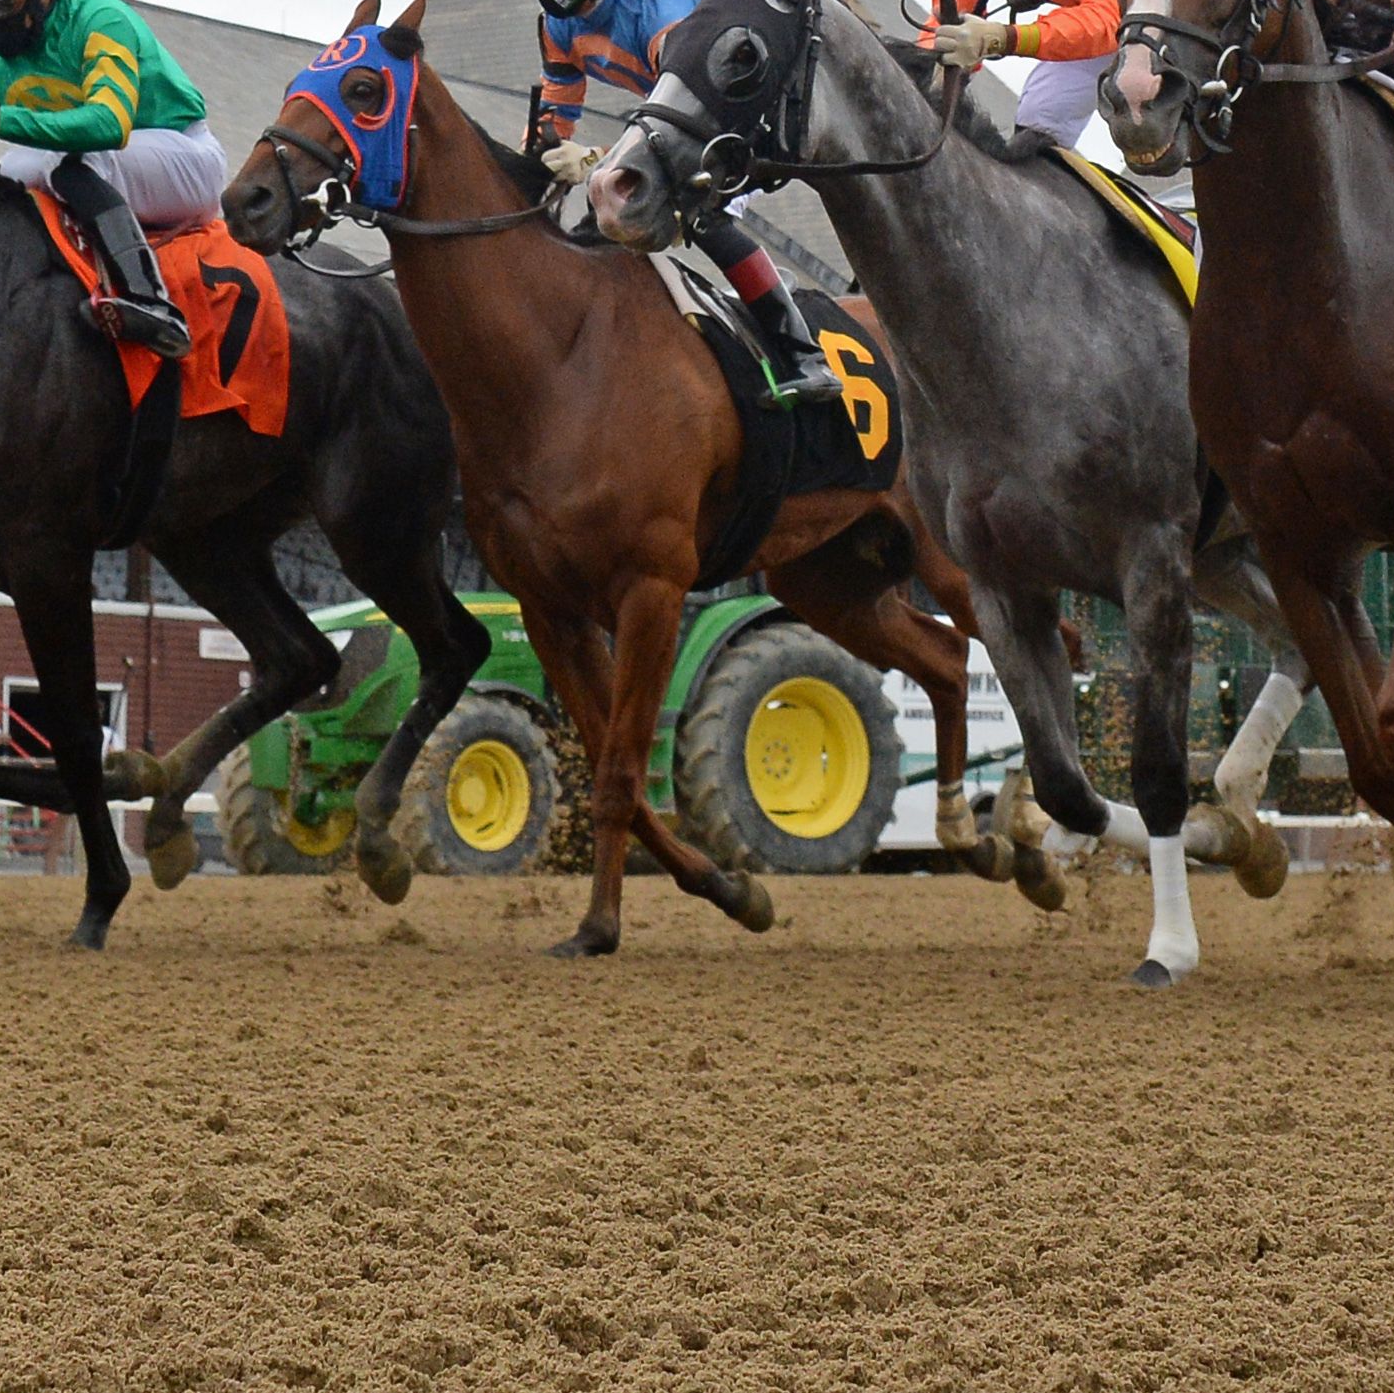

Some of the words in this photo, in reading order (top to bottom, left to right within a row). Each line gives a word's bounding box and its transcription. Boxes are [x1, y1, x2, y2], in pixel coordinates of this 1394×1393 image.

[317, 38, 349, 63] R
[198, 256, 261, 389] 7
[817, 328, 889, 461] 6
